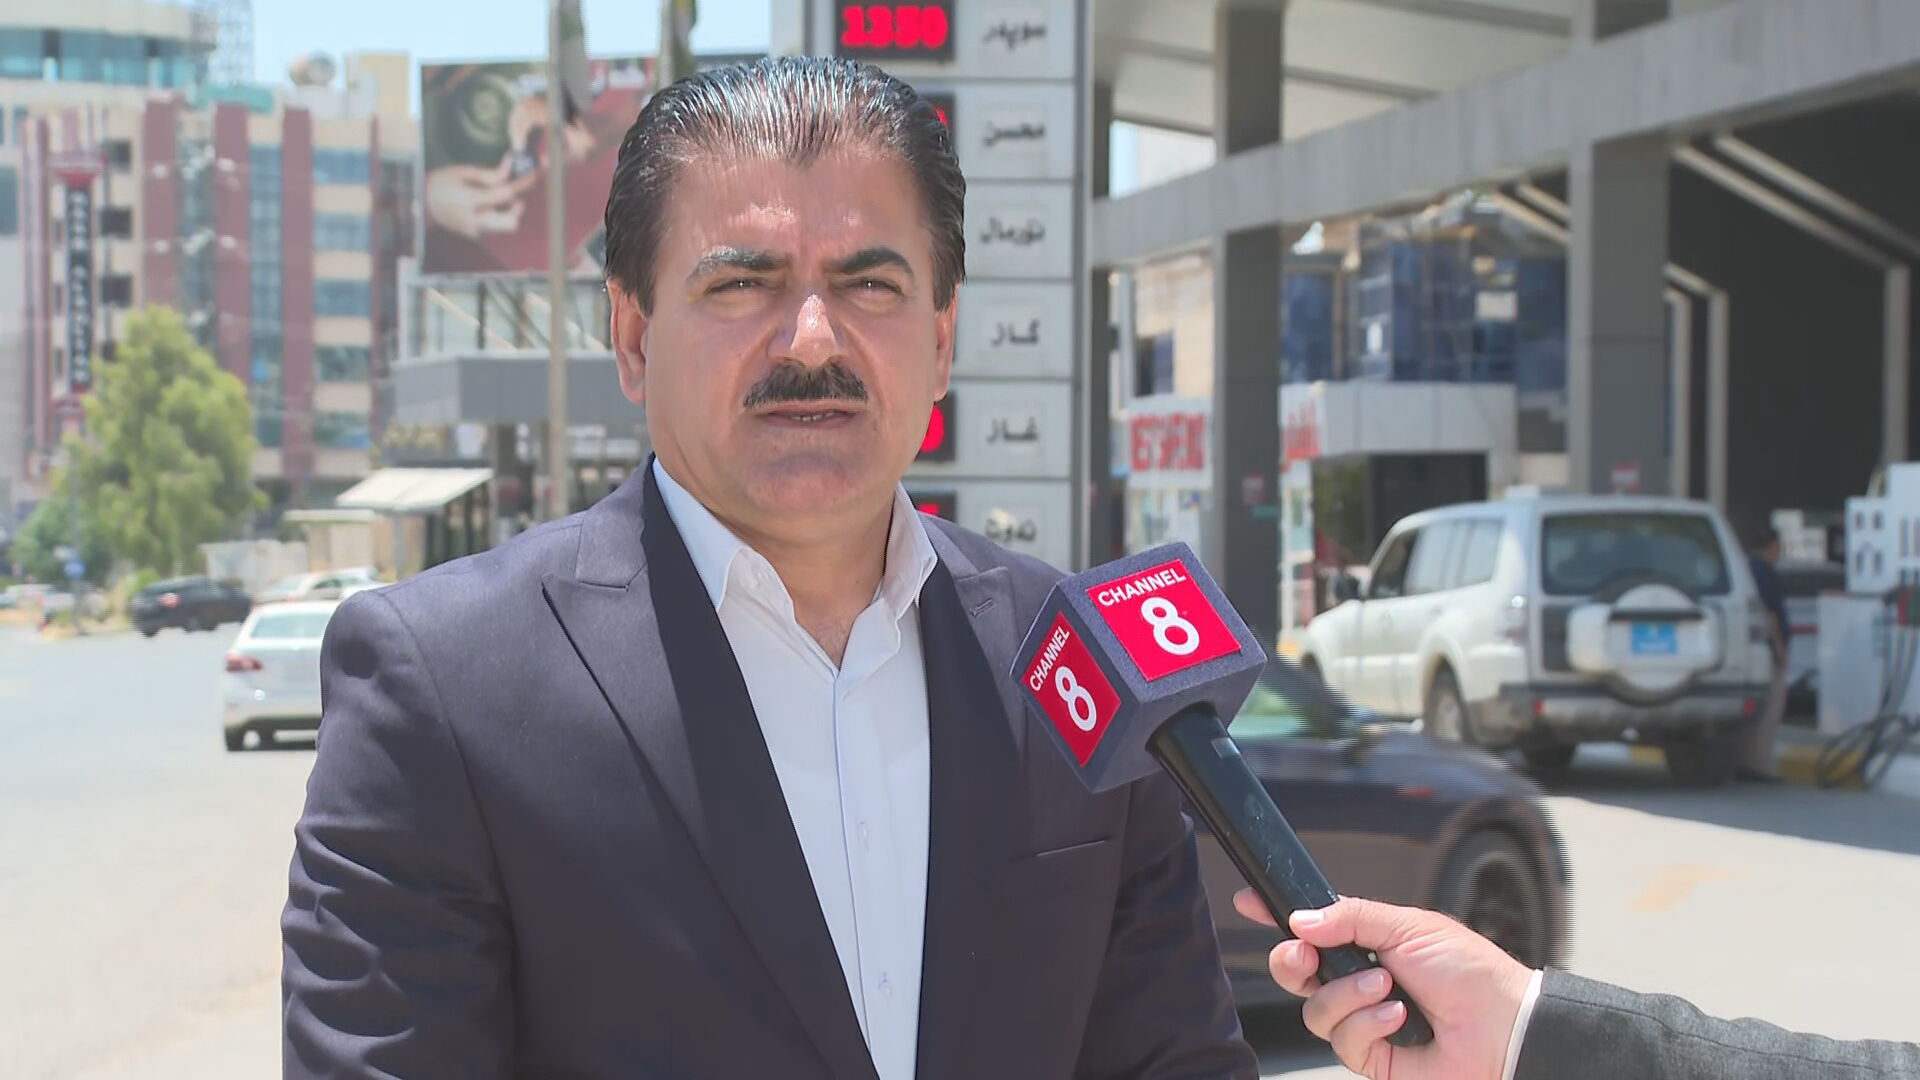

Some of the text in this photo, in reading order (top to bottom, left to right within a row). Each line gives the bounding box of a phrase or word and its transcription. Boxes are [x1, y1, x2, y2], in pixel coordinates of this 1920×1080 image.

[842, 4, 948, 49] 1350
[1098, 567, 1187, 607] CHANNEL
[1141, 597, 1200, 656] 8
[1029, 626, 1071, 692] CHANNEL
[1055, 666, 1097, 732] 8
